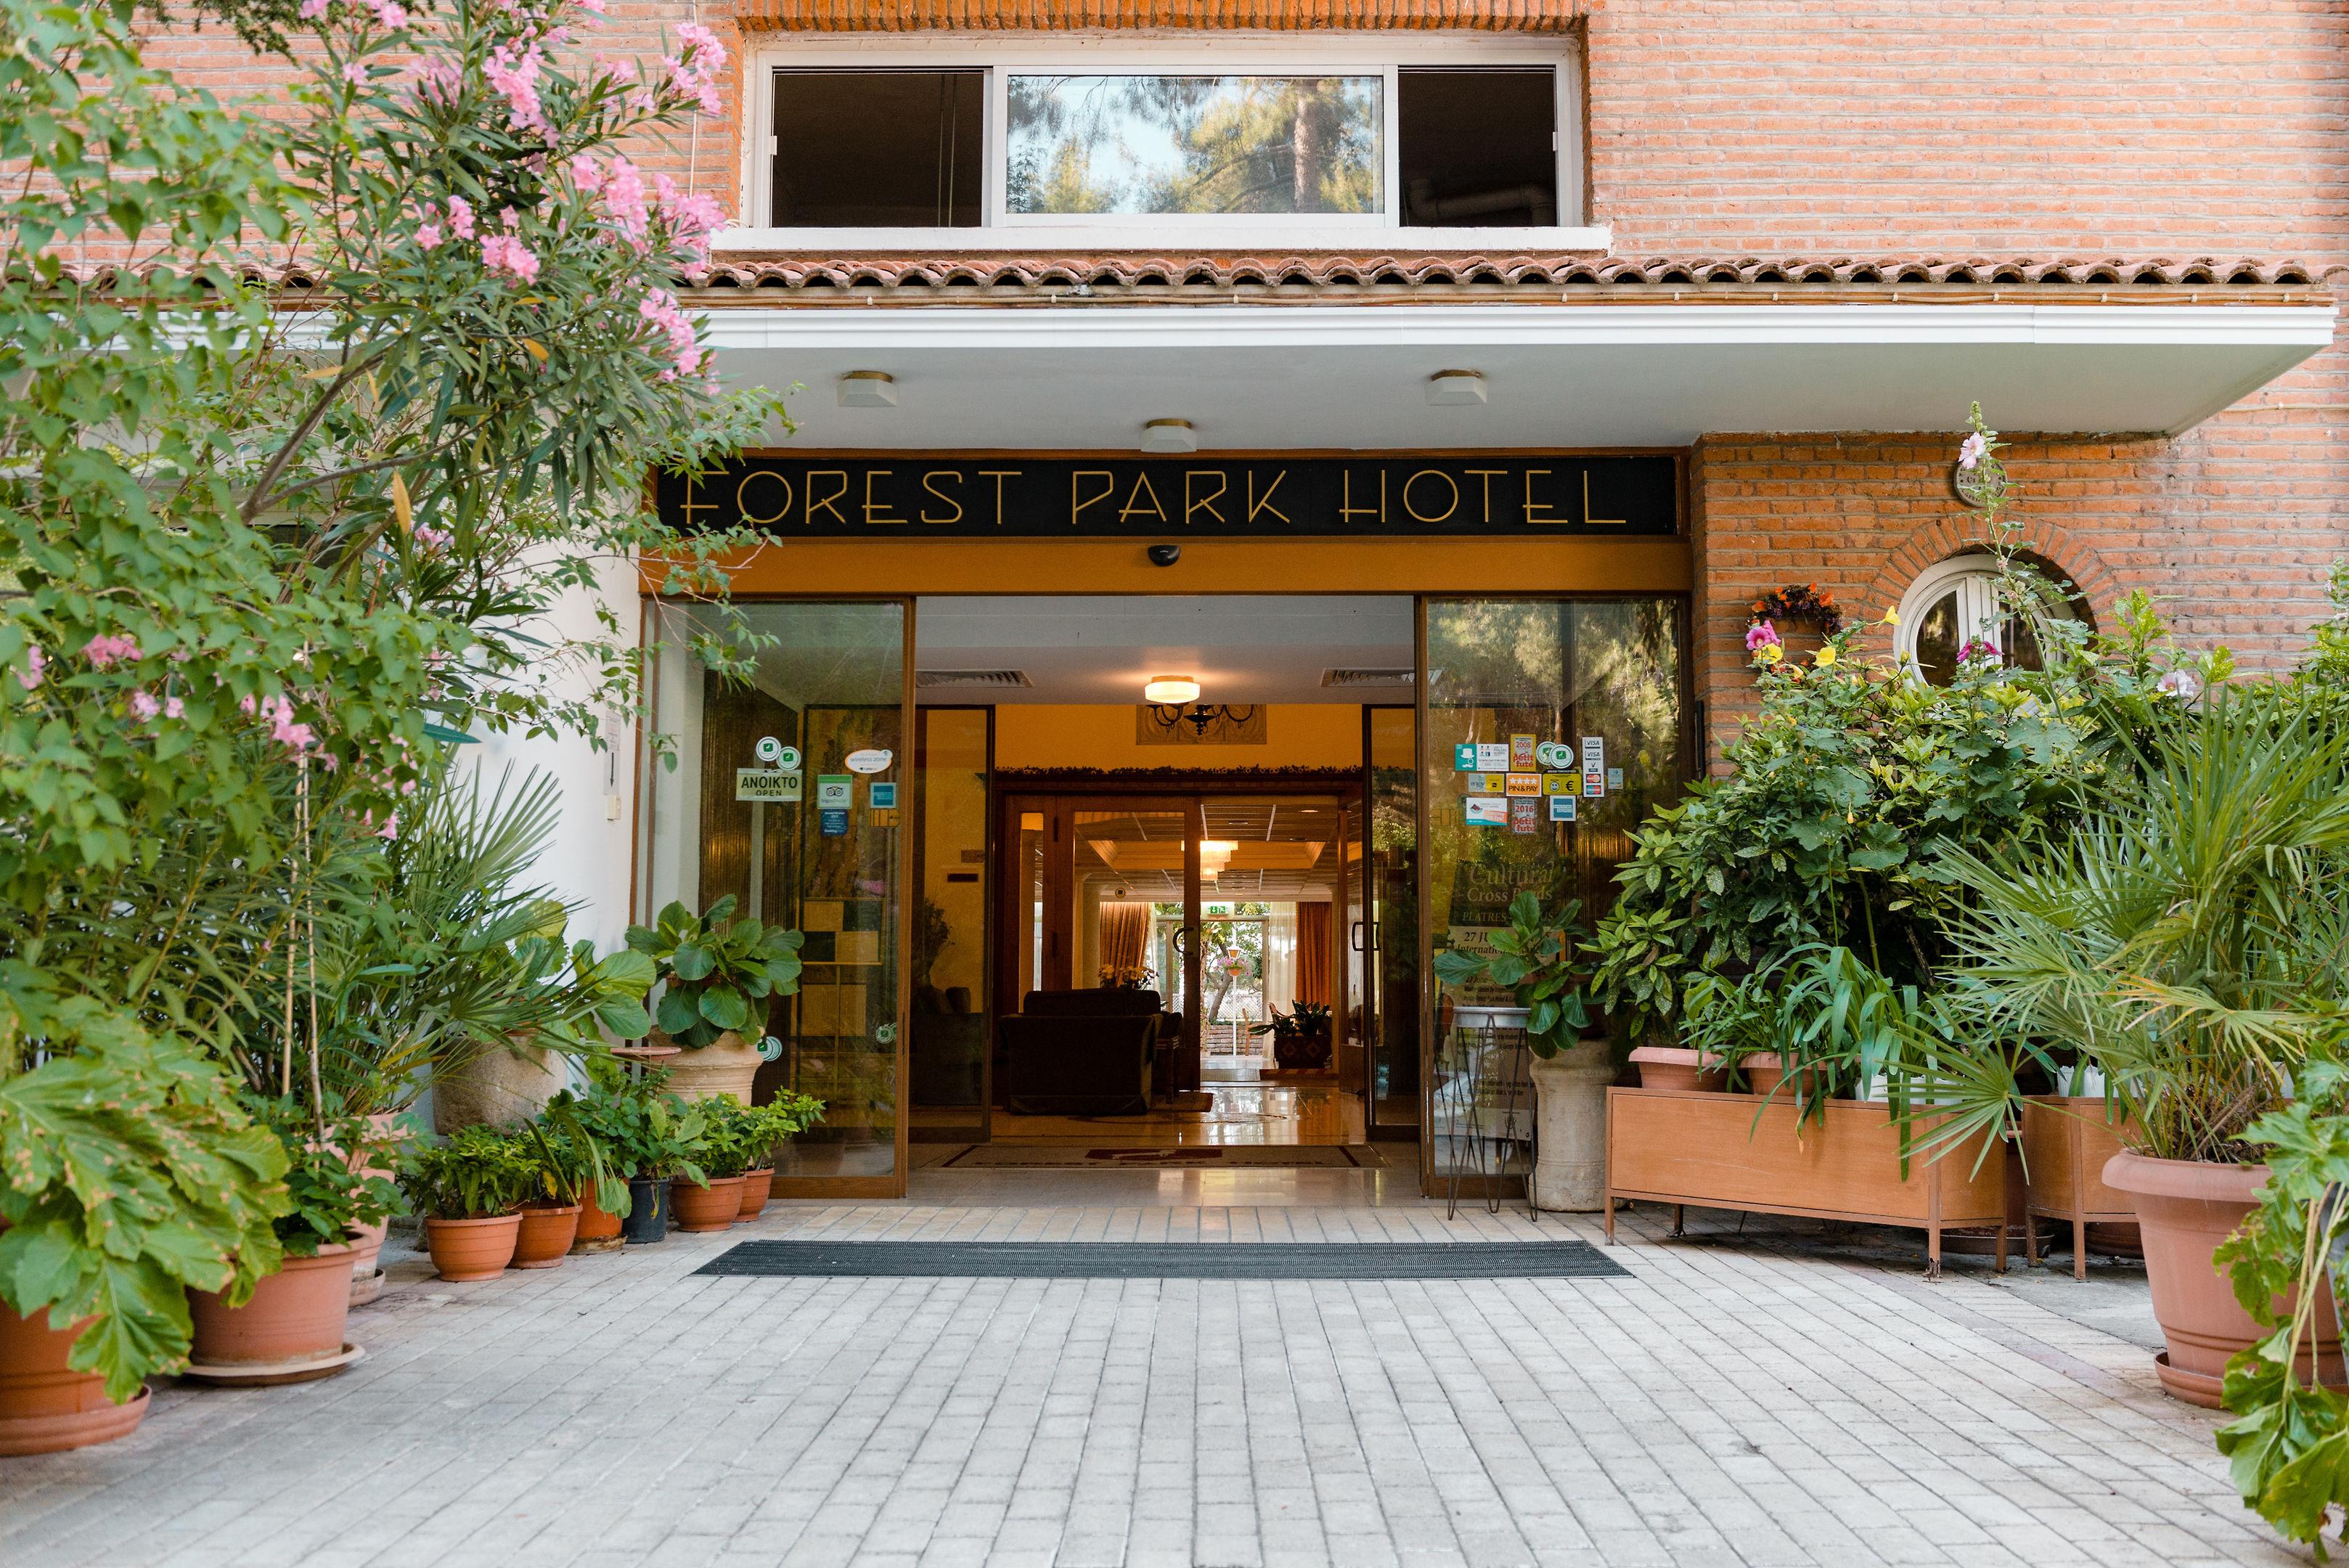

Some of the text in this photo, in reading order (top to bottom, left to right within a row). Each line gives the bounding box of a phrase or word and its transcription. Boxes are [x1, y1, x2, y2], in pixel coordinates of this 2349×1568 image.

[679, 469, 1627, 524] FOREST PARK HOTEL
[1513, 753, 1534, 762] petit
[1469, 860, 1555, 886] Cultural
[1467, 887, 1508, 902] Cross
[1463, 912, 1507, 922] PLATRES
[1464, 932, 1476, 942] 27
